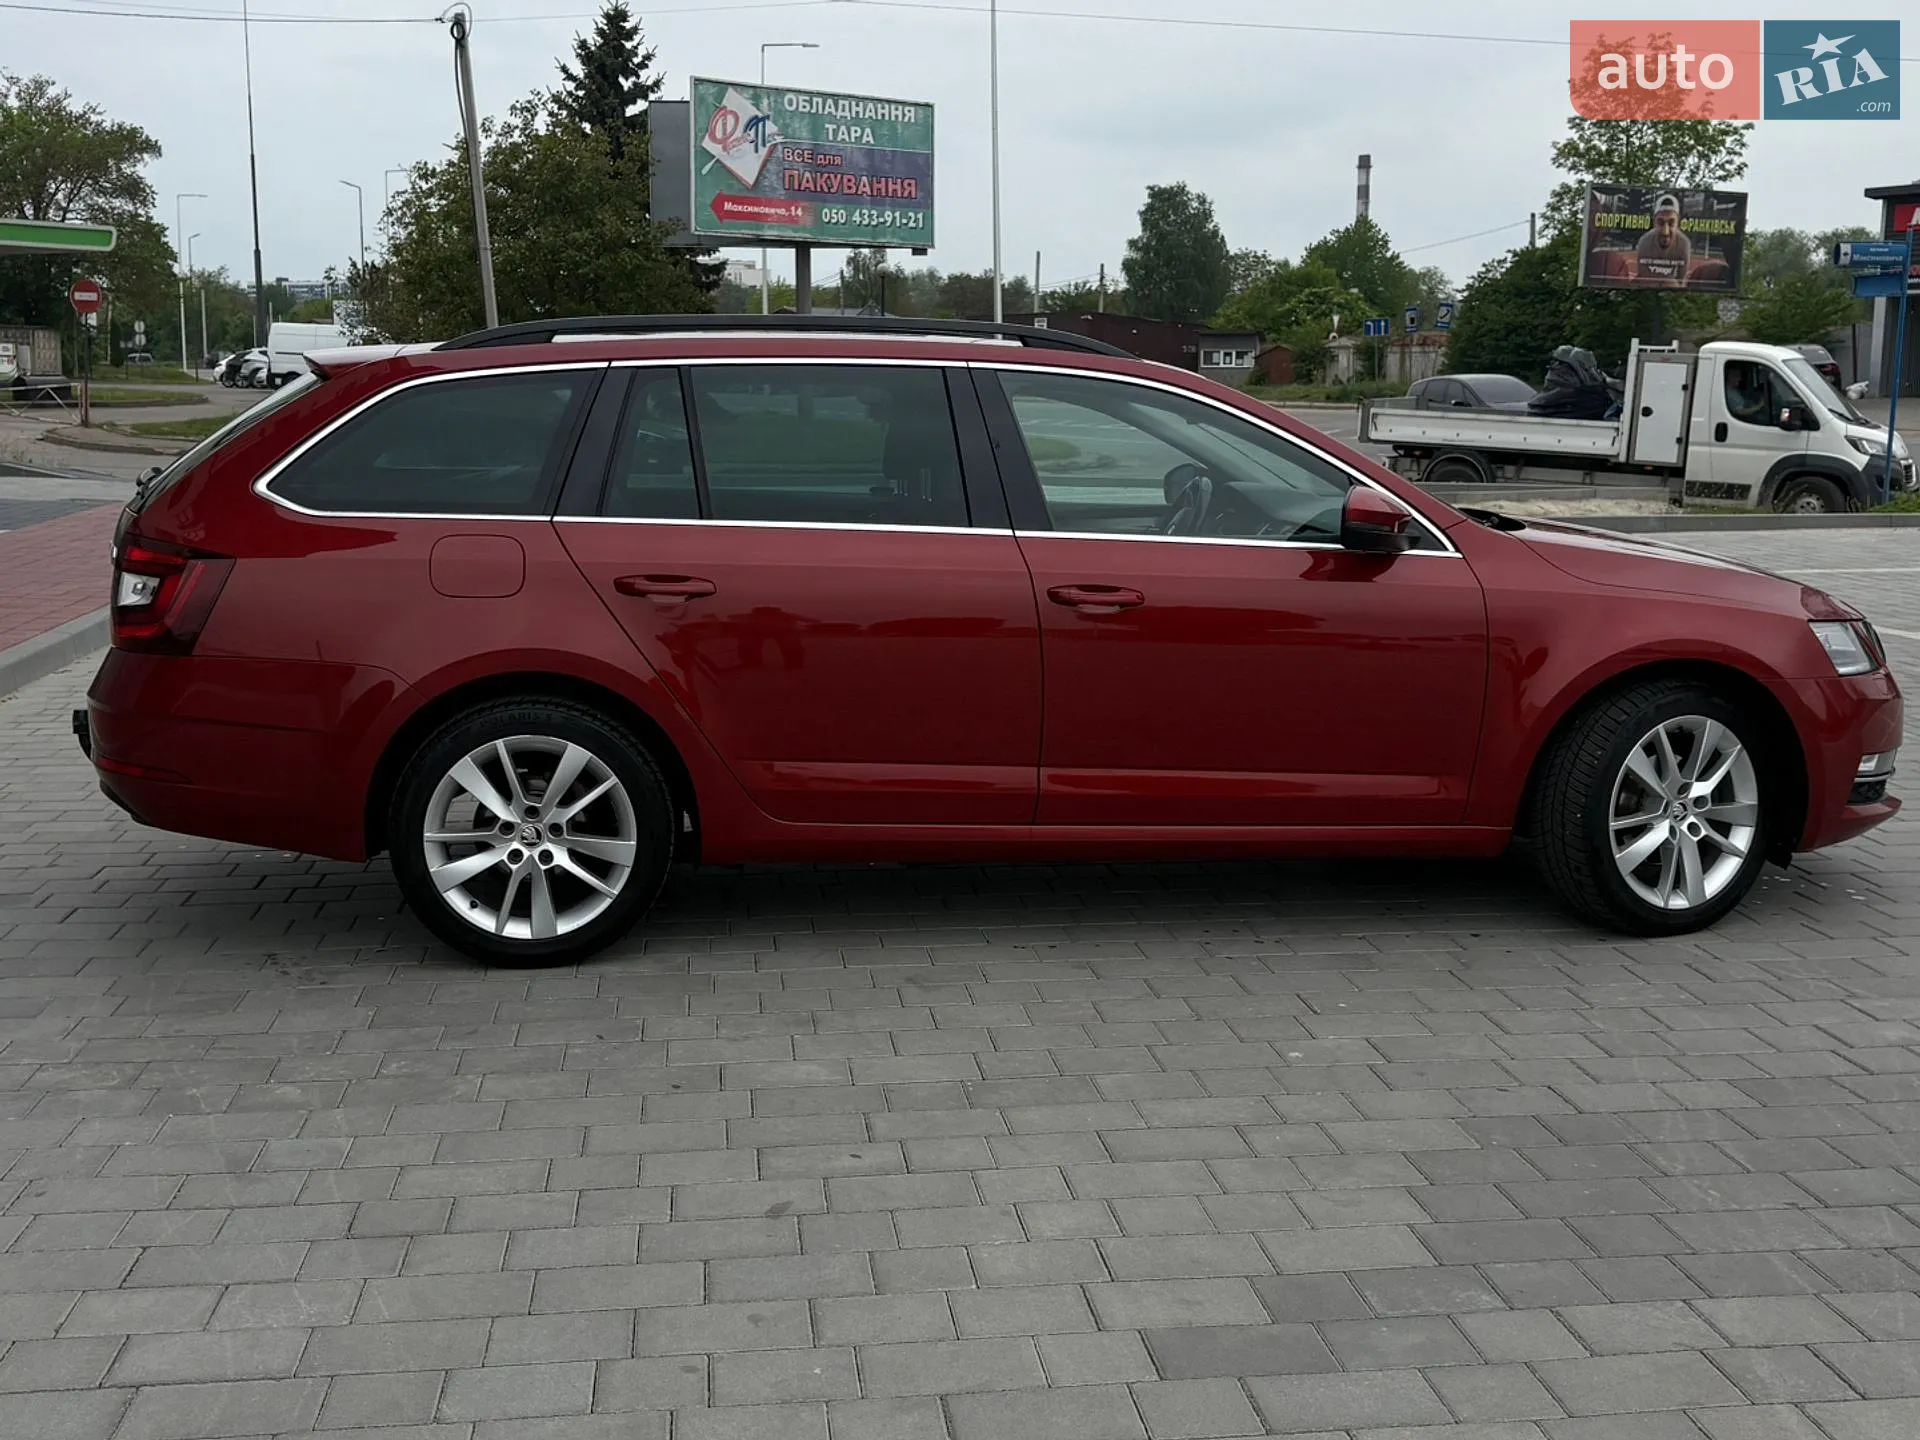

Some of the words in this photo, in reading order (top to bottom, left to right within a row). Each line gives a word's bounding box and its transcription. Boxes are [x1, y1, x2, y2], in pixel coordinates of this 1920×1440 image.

[783, 94, 916, 123] ОБЛАДНАННЯ
[825, 123, 875, 144] ТАРА
[783, 148, 813, 163] ВСЕ
[817, 154, 842, 167] для
[783, 168, 918, 199] ПАКУВАННЯ
[822, 208, 847, 224] 050
[852, 209, 925, 228] 433-91-21
[1594, 213, 1651, 230] СПОРТИВНО
[1680, 218, 1737, 234] ФРАНКІВСЬК
